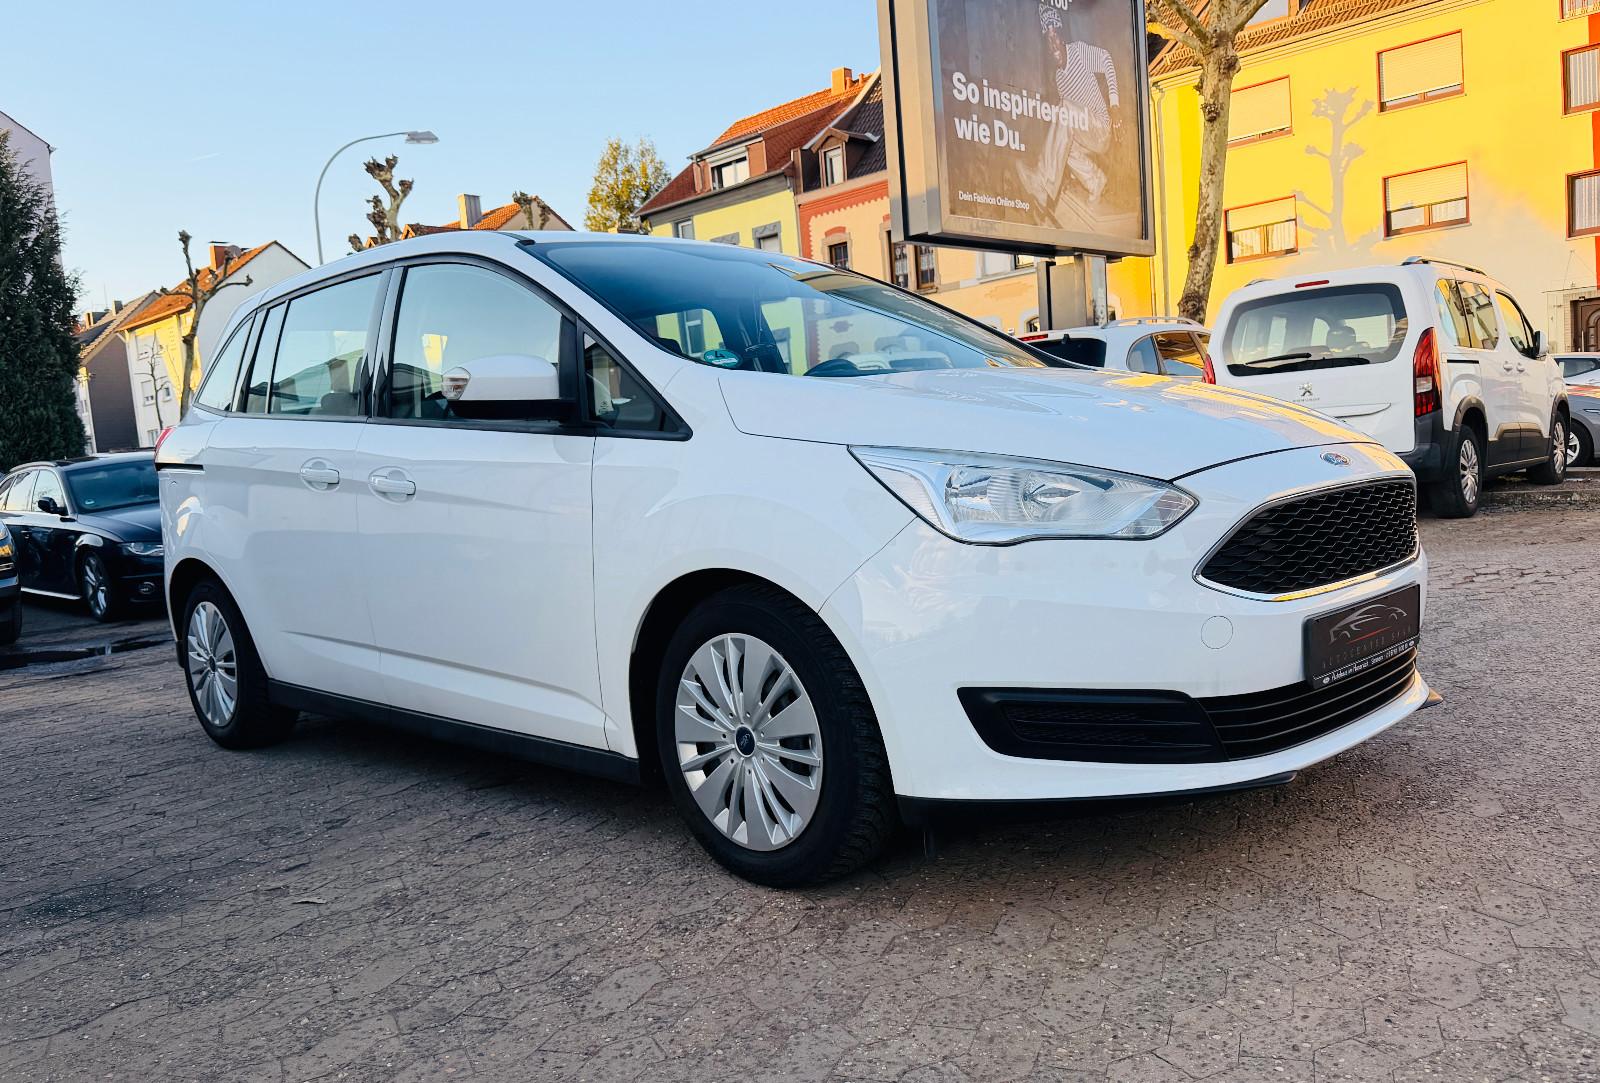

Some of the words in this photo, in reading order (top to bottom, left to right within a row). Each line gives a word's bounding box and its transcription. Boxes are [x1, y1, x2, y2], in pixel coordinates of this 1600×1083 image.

[952, 72, 980, 104] So
[982, 79, 1089, 132] inspirierend
[954, 114, 991, 145] wie
[993, 119, 1026, 151] Du.
[958, 190, 973, 202] Dein
[973, 192, 996, 205] Fashion
[996, 196, 1015, 208] Online
[1015, 199, 1030, 211] Shop
